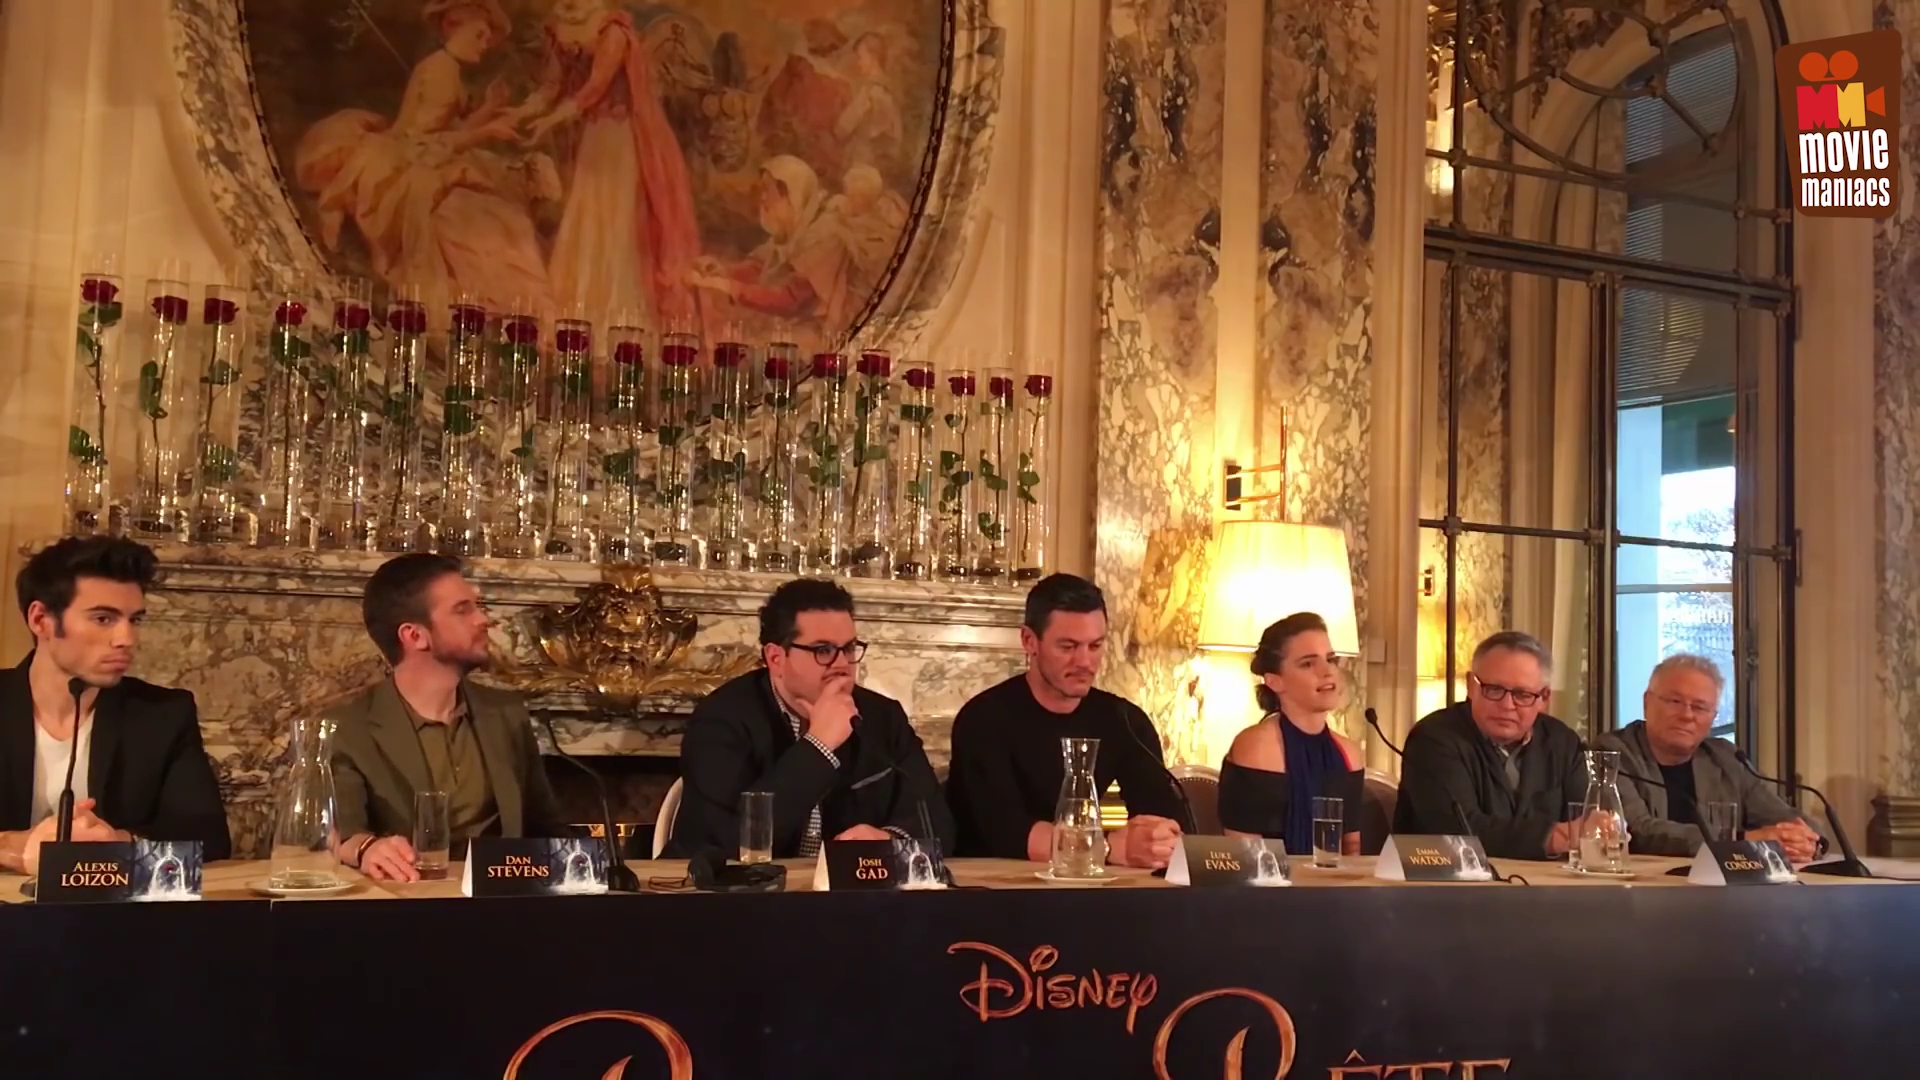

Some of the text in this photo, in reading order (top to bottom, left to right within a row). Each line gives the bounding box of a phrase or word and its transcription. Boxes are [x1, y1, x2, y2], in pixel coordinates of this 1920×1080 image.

[1210, 850, 1232, 860] LUKE
[1416, 848, 1440, 857] EMMA
[505, 855, 531, 865] DAN
[858, 856, 882, 868] JOSH
[1204, 859, 1241, 871] EVANS
[1410, 856, 1452, 865] WATSON
[1724, 860, 1764, 870] CONDON
[73, 861, 119, 873] ALEXIS
[487, 865, 550, 878] STEVENS
[61, 873, 129, 887] LOIZON
[856, 868, 888, 880] GAD
